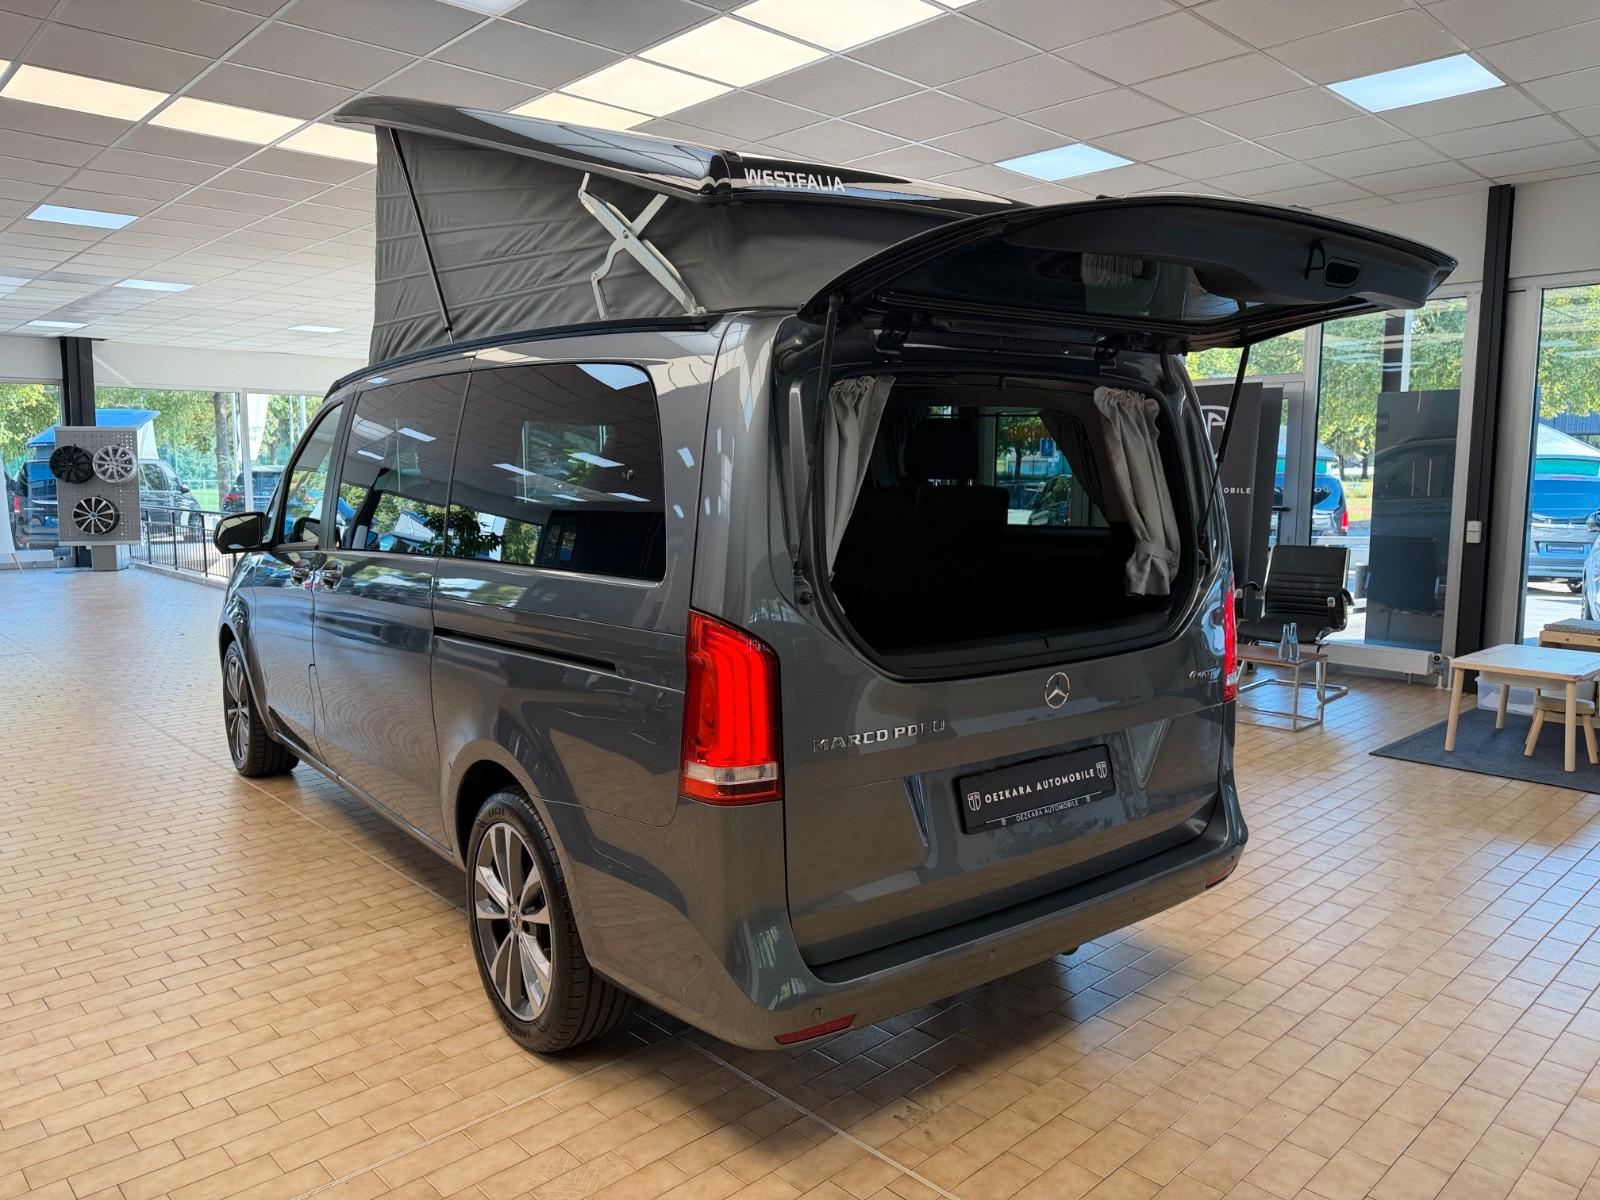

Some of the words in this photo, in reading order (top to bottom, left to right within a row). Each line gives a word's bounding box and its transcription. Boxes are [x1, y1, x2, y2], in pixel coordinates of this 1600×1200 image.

[744, 167, 846, 192] WESTFALIA
[812, 729, 889, 753] MARCO
[984, 784, 1032, 804] OEZKARA
[1036, 768, 1095, 791] AUTOMOBILE
[1015, 808, 1043, 822] OEZKARA
[1044, 799, 1080, 815] AUTOMOBILE
